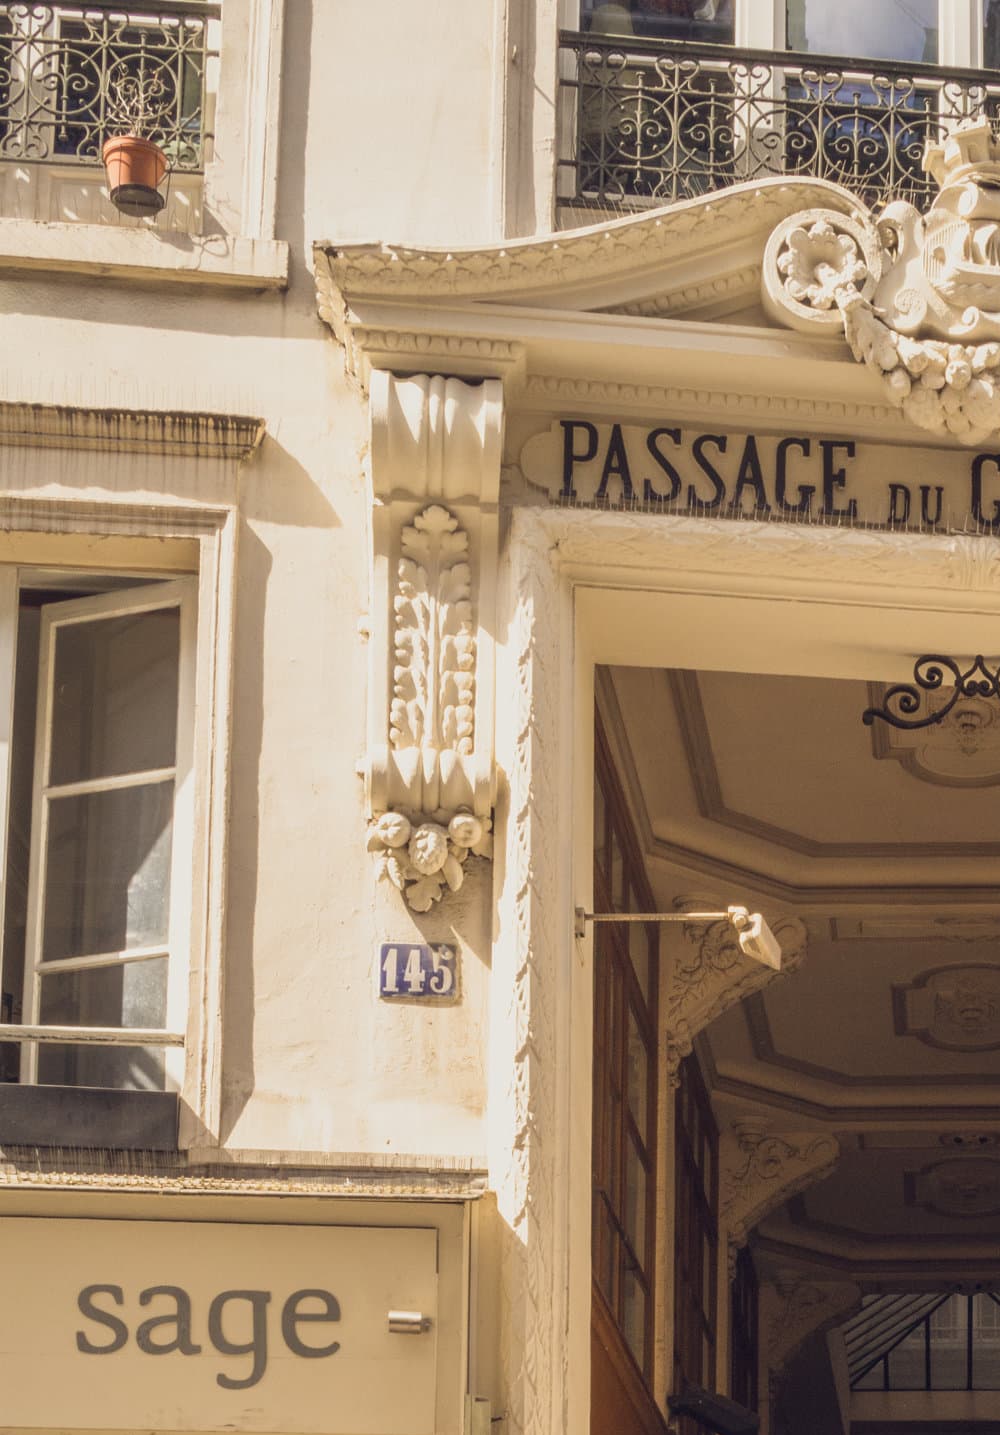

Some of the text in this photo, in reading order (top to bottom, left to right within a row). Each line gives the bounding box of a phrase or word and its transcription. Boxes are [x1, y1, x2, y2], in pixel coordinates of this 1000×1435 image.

[559, 419, 858, 517] PASSAGE
[887, 482, 945, 525] DU
[381, 945, 454, 993] 145
[75, 1283, 342, 1390] sage
